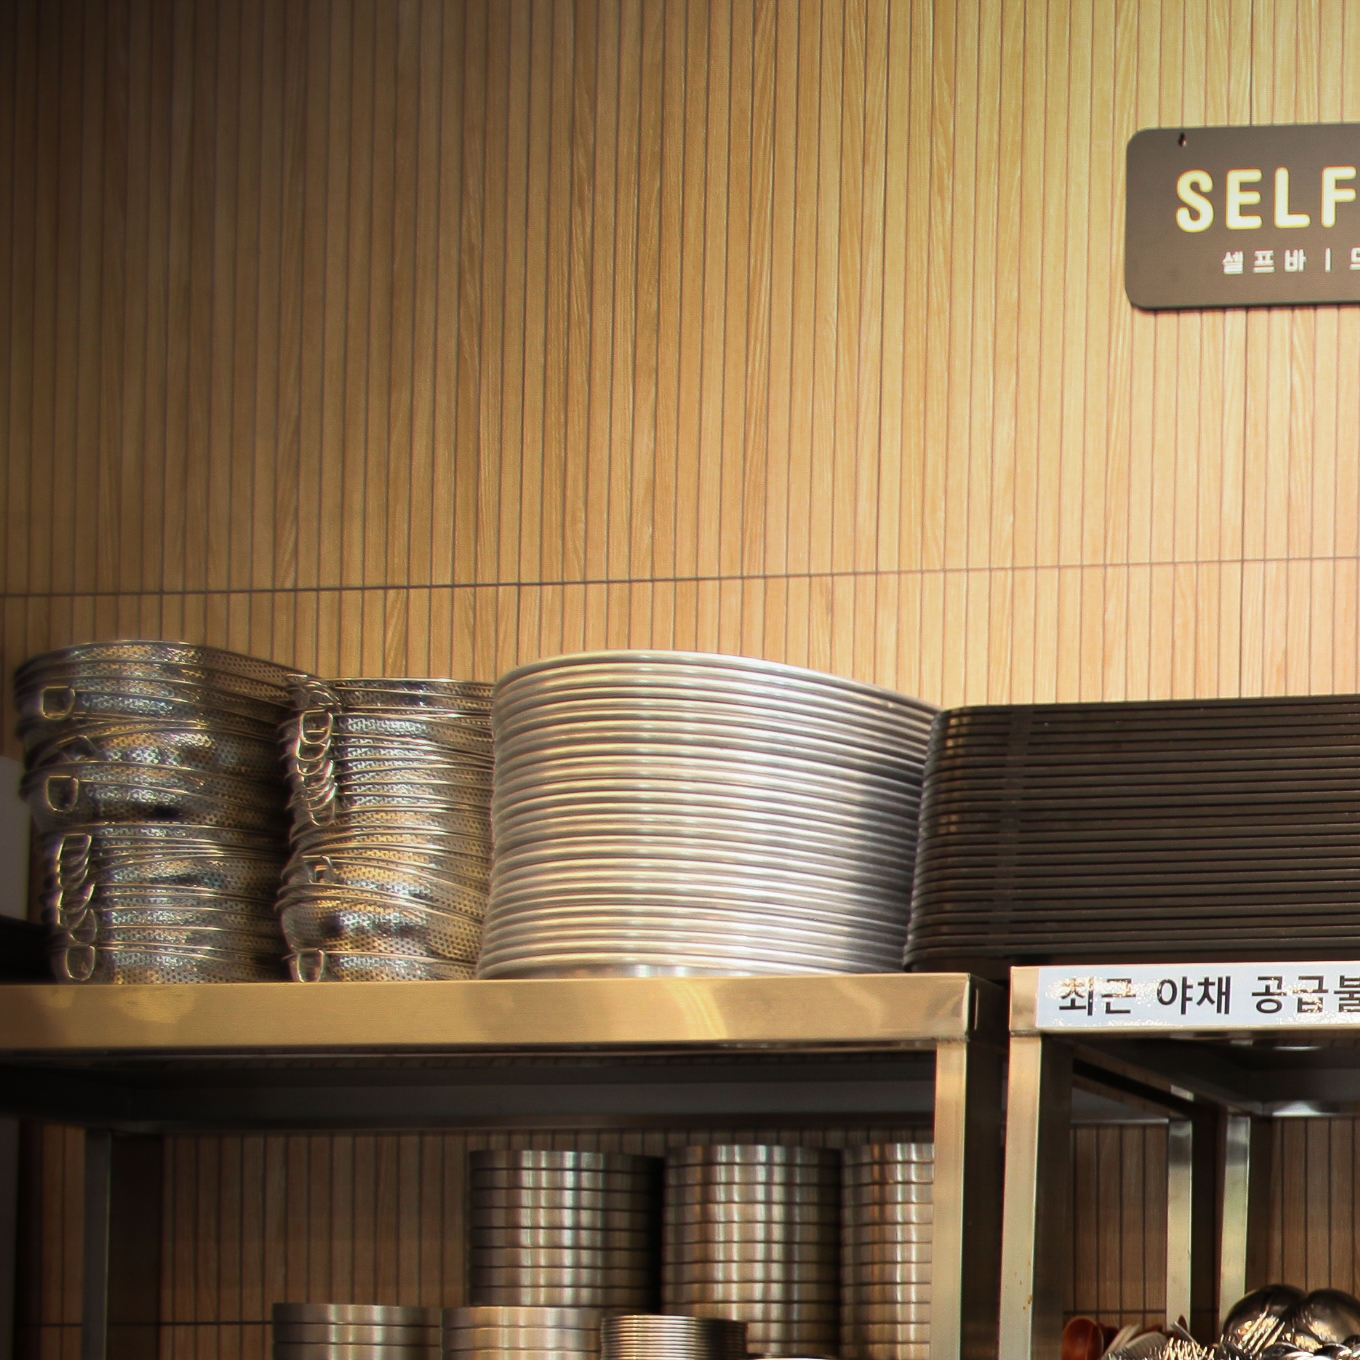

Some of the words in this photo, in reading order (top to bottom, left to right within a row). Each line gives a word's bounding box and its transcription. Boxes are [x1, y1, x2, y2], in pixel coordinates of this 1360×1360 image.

[1175, 165, 1358, 233] SELF
[1058, 974, 1136, 1016] 최근
[1155, 973, 1232, 1016] 야채
